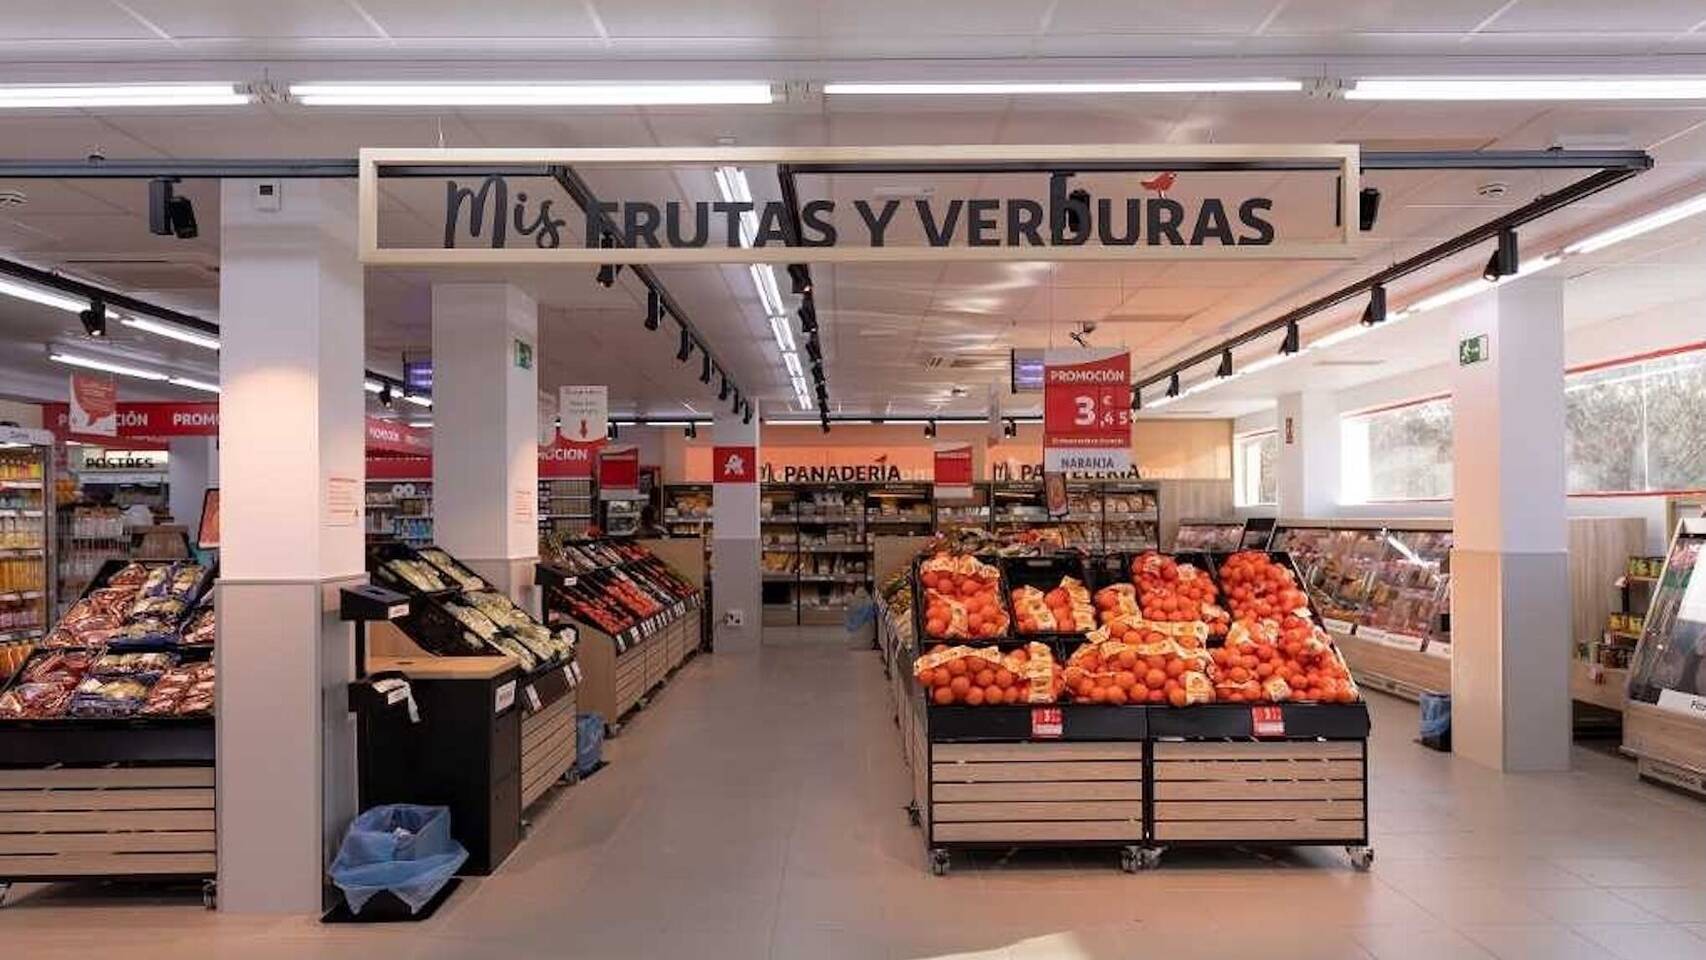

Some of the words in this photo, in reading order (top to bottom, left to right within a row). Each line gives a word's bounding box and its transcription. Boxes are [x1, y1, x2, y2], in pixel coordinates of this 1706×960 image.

[444, 175, 566, 248] Mis
[584, 199, 838, 248] FRUTAS
[856, 199, 900, 247] Y
[915, 198, 1275, 247] VERDURAS
[1050, 369, 1125, 383] PROMOCIÓN
[1074, 395, 1096, 426] 3
[1060, 458, 1115, 469] NARANJA
